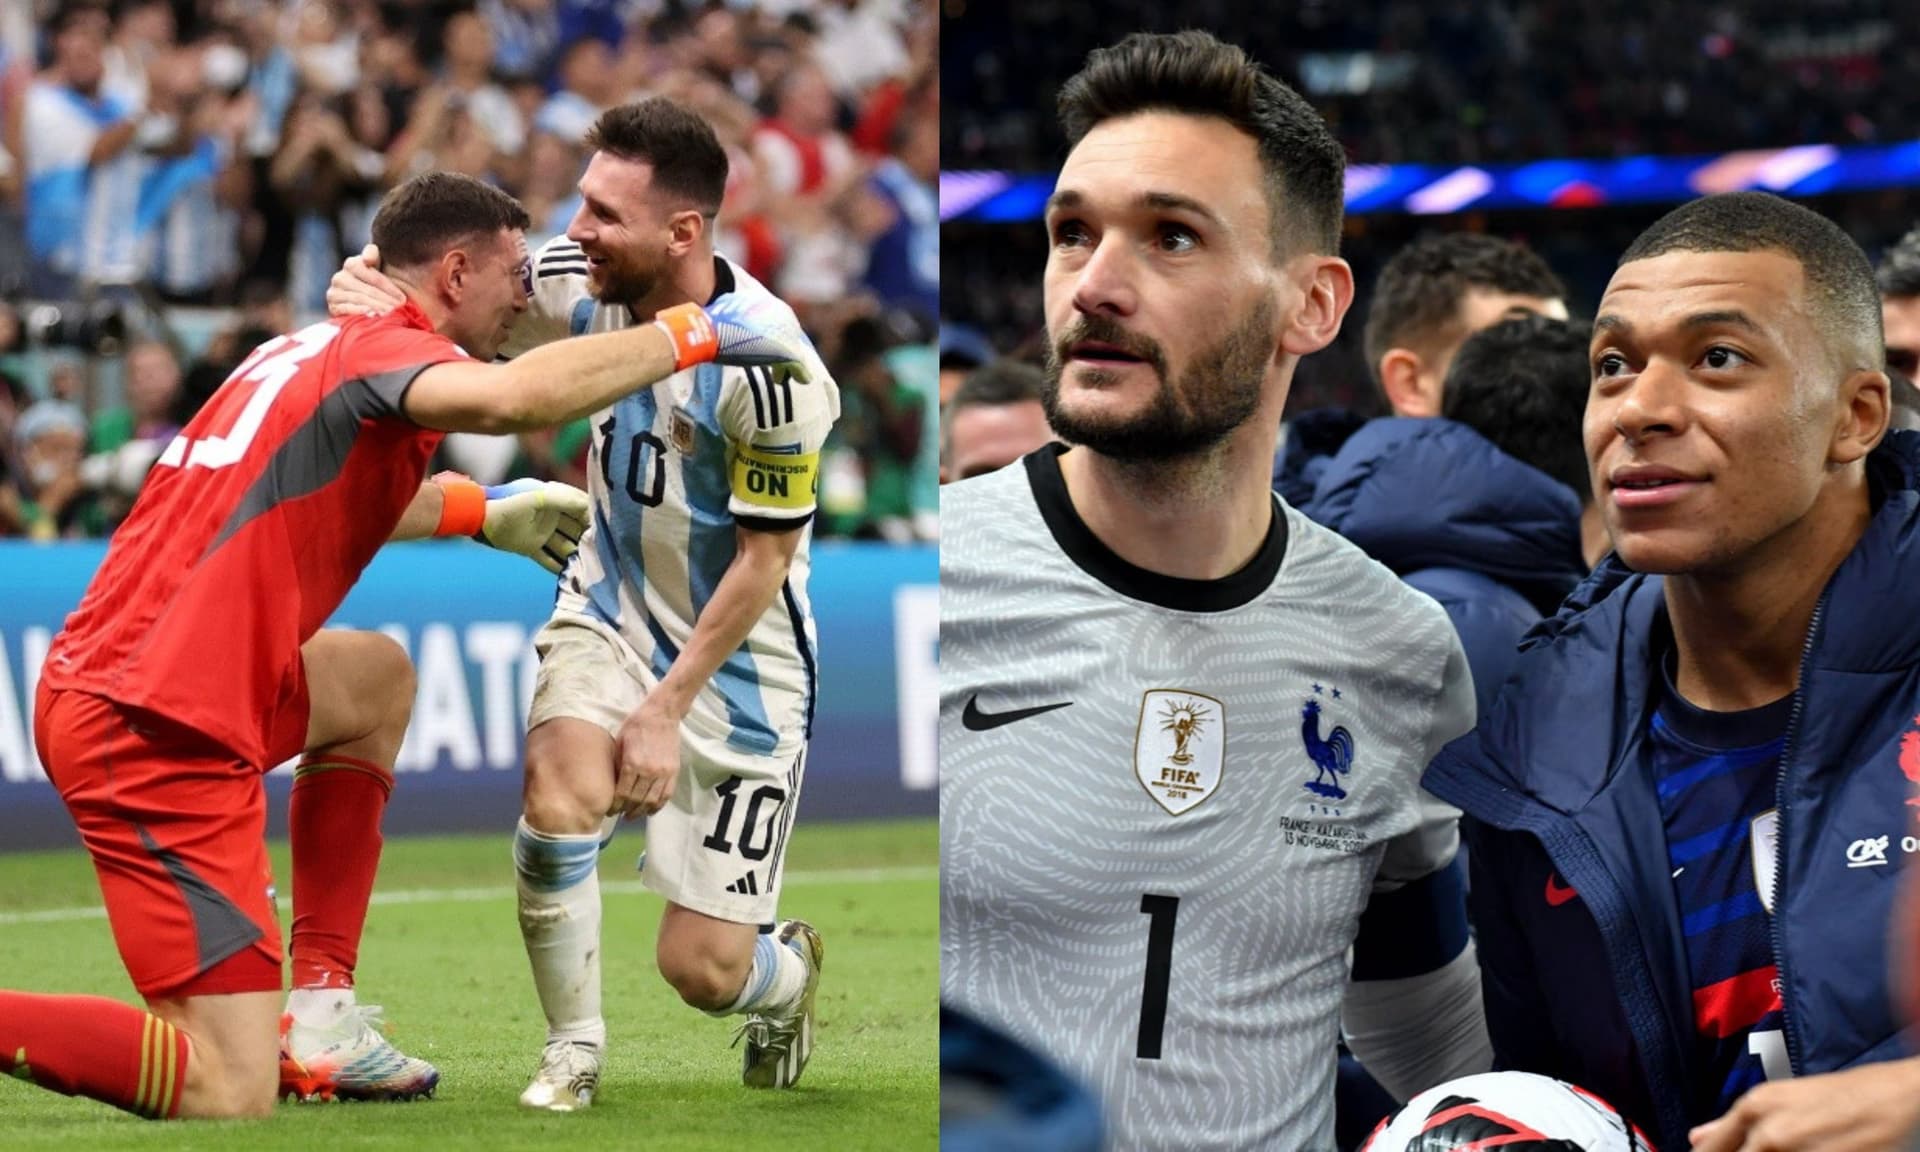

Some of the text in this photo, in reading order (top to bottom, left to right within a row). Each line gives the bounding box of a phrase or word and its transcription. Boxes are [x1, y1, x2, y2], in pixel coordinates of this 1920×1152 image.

[599, 416, 667, 508] 10
[747, 469, 788, 497] NO
[703, 774, 786, 861] 10
[1162, 768, 1196, 785] FIFA
[1136, 893, 1181, 1059] 1
